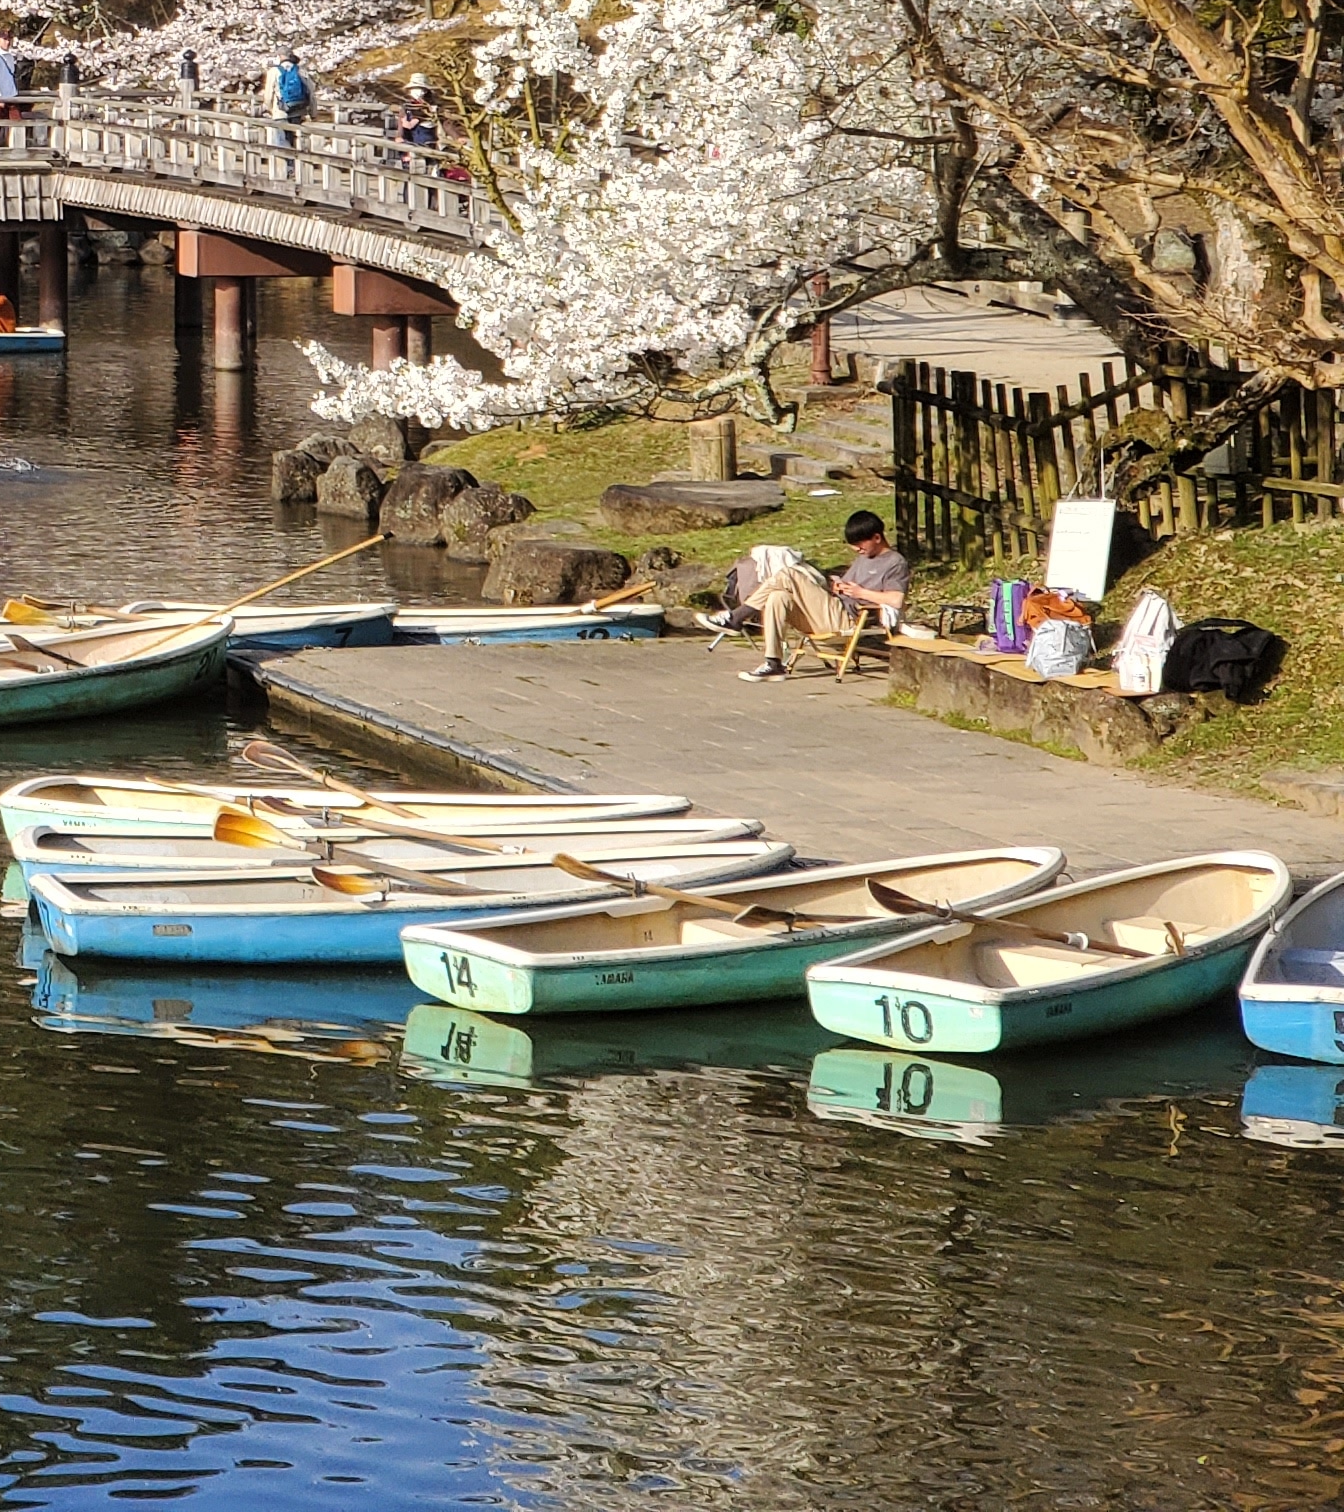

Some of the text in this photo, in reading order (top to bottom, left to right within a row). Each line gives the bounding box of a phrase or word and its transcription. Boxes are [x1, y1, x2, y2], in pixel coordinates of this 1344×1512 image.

[334, 627, 353, 648] 7
[440, 951, 476, 999] 14
[874, 995, 933, 1044] 10
